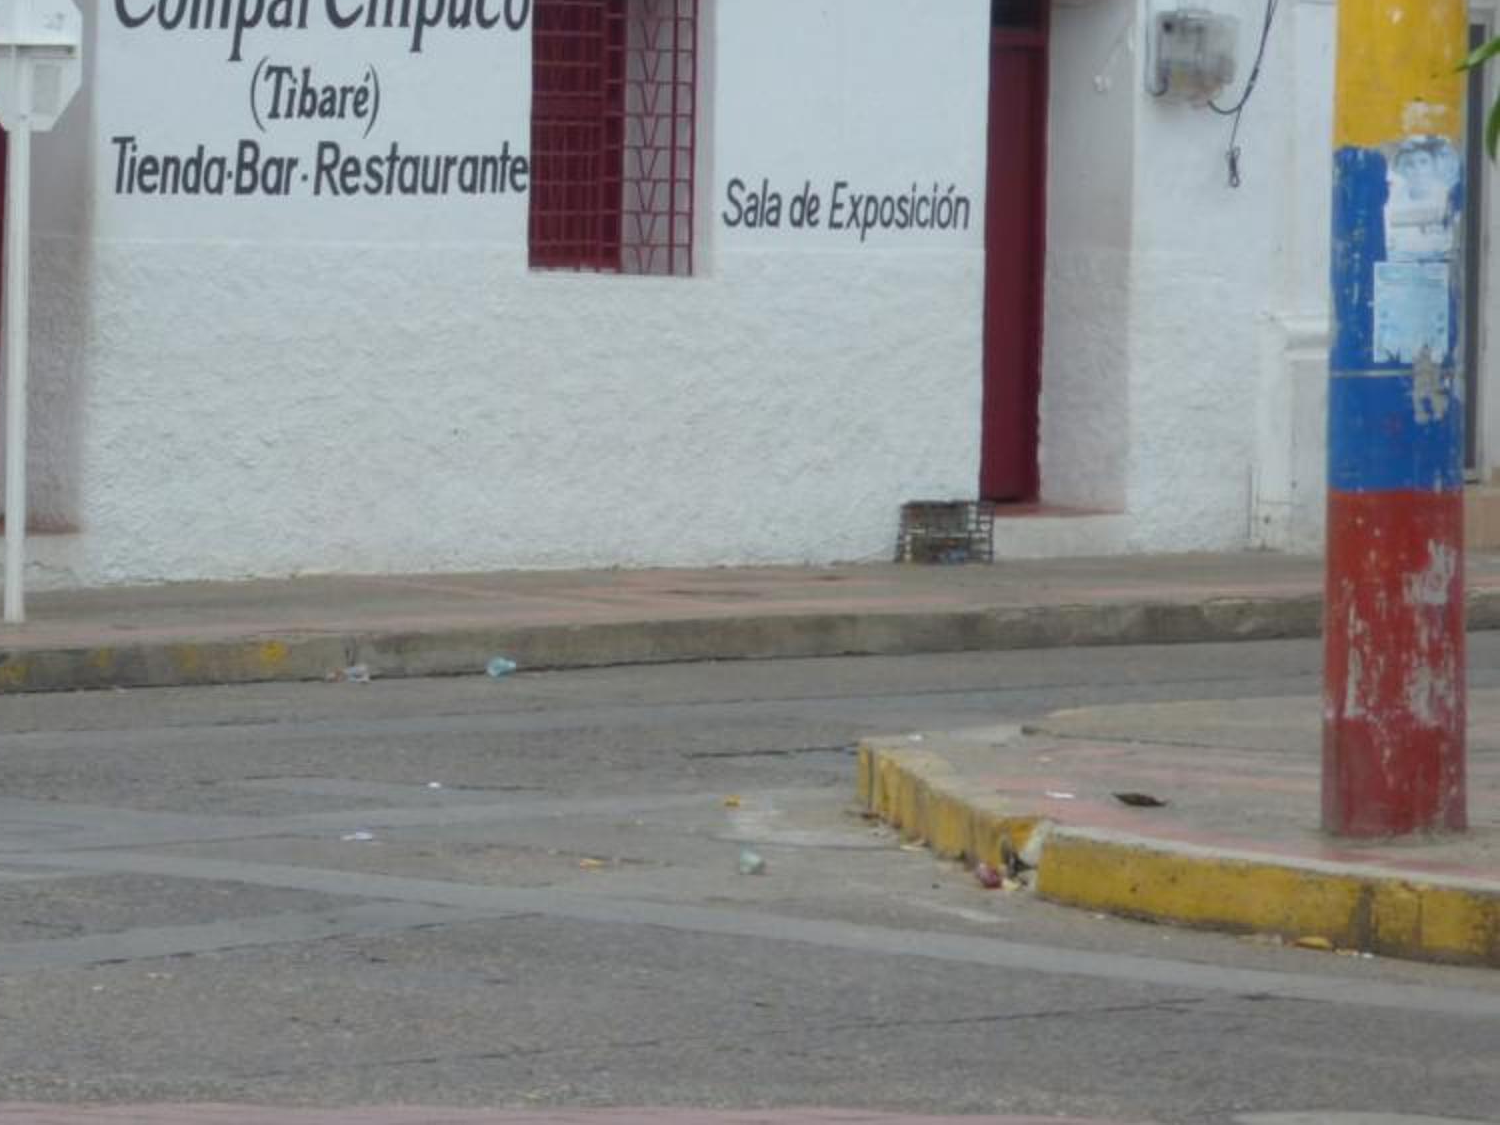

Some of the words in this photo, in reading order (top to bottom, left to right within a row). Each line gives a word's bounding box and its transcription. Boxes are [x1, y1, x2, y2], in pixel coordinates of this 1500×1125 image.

[250, 57, 380, 138] (Tibaré)
[722, 178, 782, 228] Sala
[789, 181, 820, 228] de
[828, 181, 970, 243] Exposición
